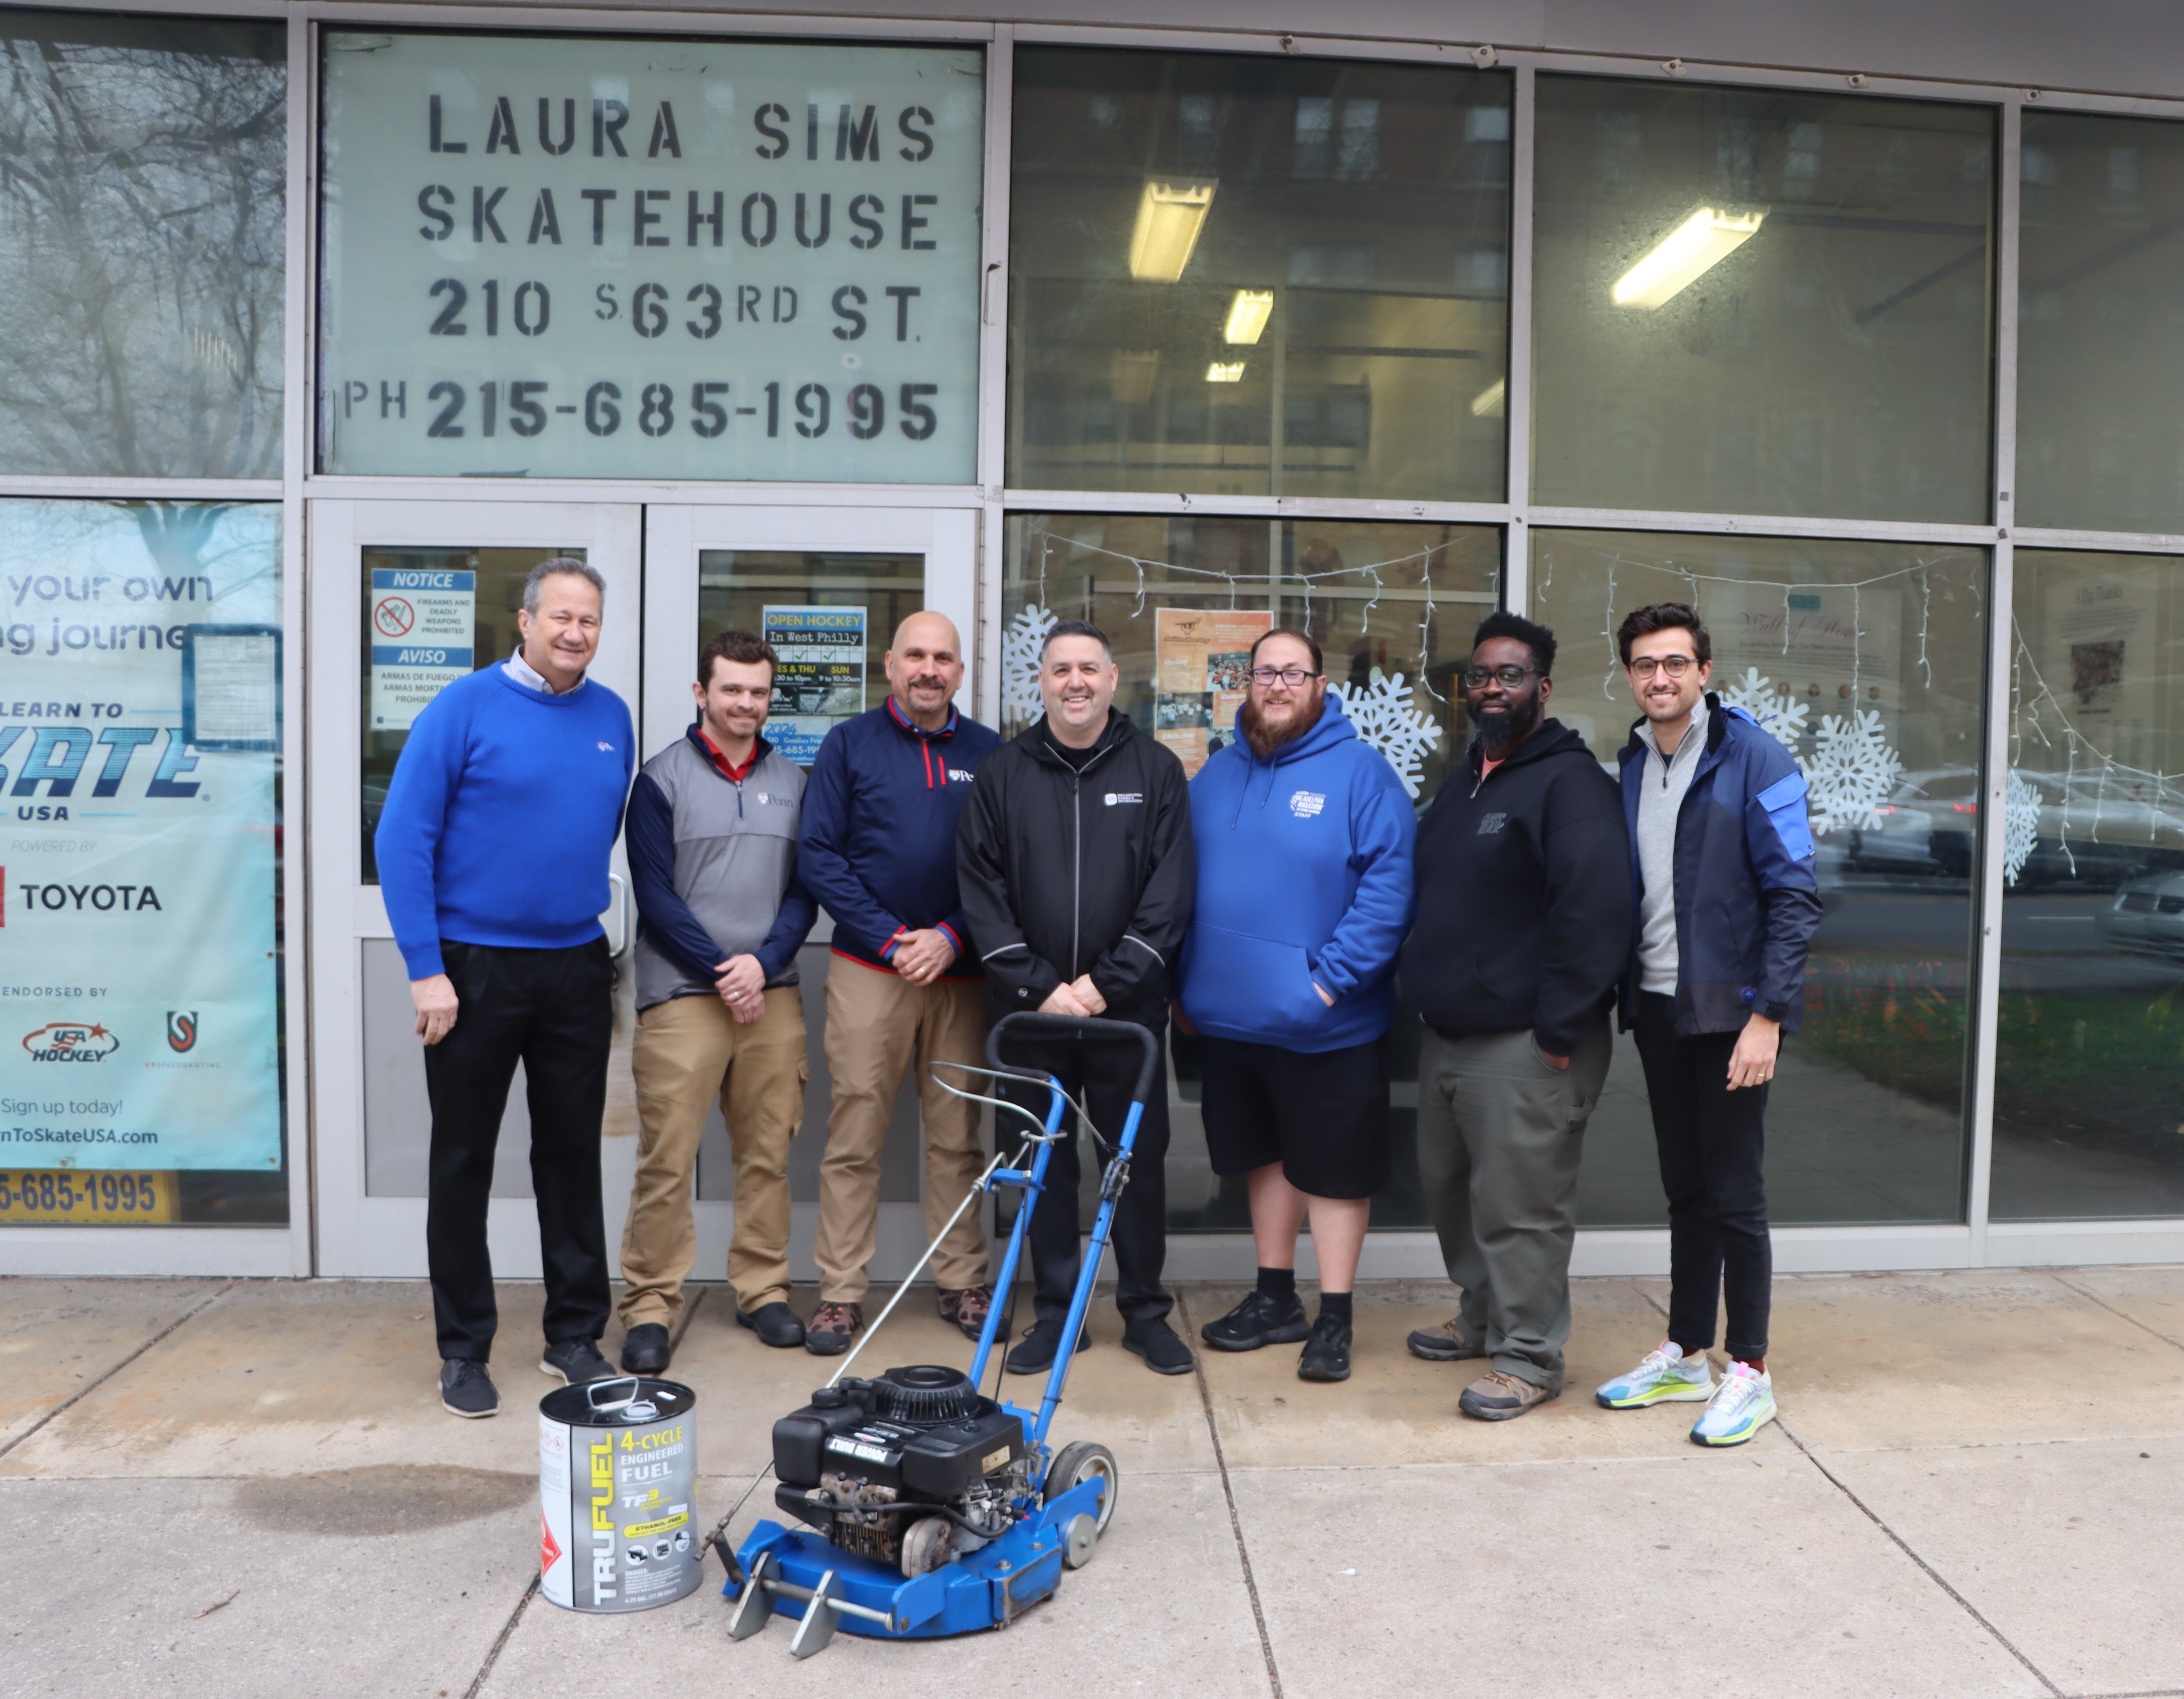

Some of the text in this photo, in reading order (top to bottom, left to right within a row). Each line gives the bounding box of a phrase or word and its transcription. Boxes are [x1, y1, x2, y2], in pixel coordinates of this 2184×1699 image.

[430, 94, 935, 161] LAURA SIMS
[417, 185, 938, 250] SKATEHOUSE
[429, 278, 550, 336] 210
[831, 285, 922, 342] ST.
[345, 380, 938, 440] PH 215-685-1995
[394, 572, 454, 587] NOTICE
[7, 575, 213, 606] your own
[767, 615, 862, 627] OPEN HOCKEY
[770, 631, 859, 645] In West Philly
[398, 650, 446, 664] AVISO
[798, 665, 816, 673] THU
[831, 666, 849, 674] SUN
[0, 702, 123, 719] LEARN TO
[769, 793, 793, 807] Penn
[17, 806, 69, 821] USA
[12, 840, 98, 853] POWERED BY
[20, 884, 163, 911] TOYOTA
[3, 986, 109, 997] ENDORSED BY
[54, 1030, 87, 1043] USA
[32, 1049, 107, 1062] HOCKEY
[1, 1099, 123, 1116] Sign up today!
[621, 1425, 682, 1451] 4-CYCLE
[621, 1443, 684, 1466] ENGINEERED
[828, 1438, 888, 1463] POWER BUILT
[622, 1461, 673, 1482] FUEL
[591, 1432, 617, 1605] TRUFUEL
